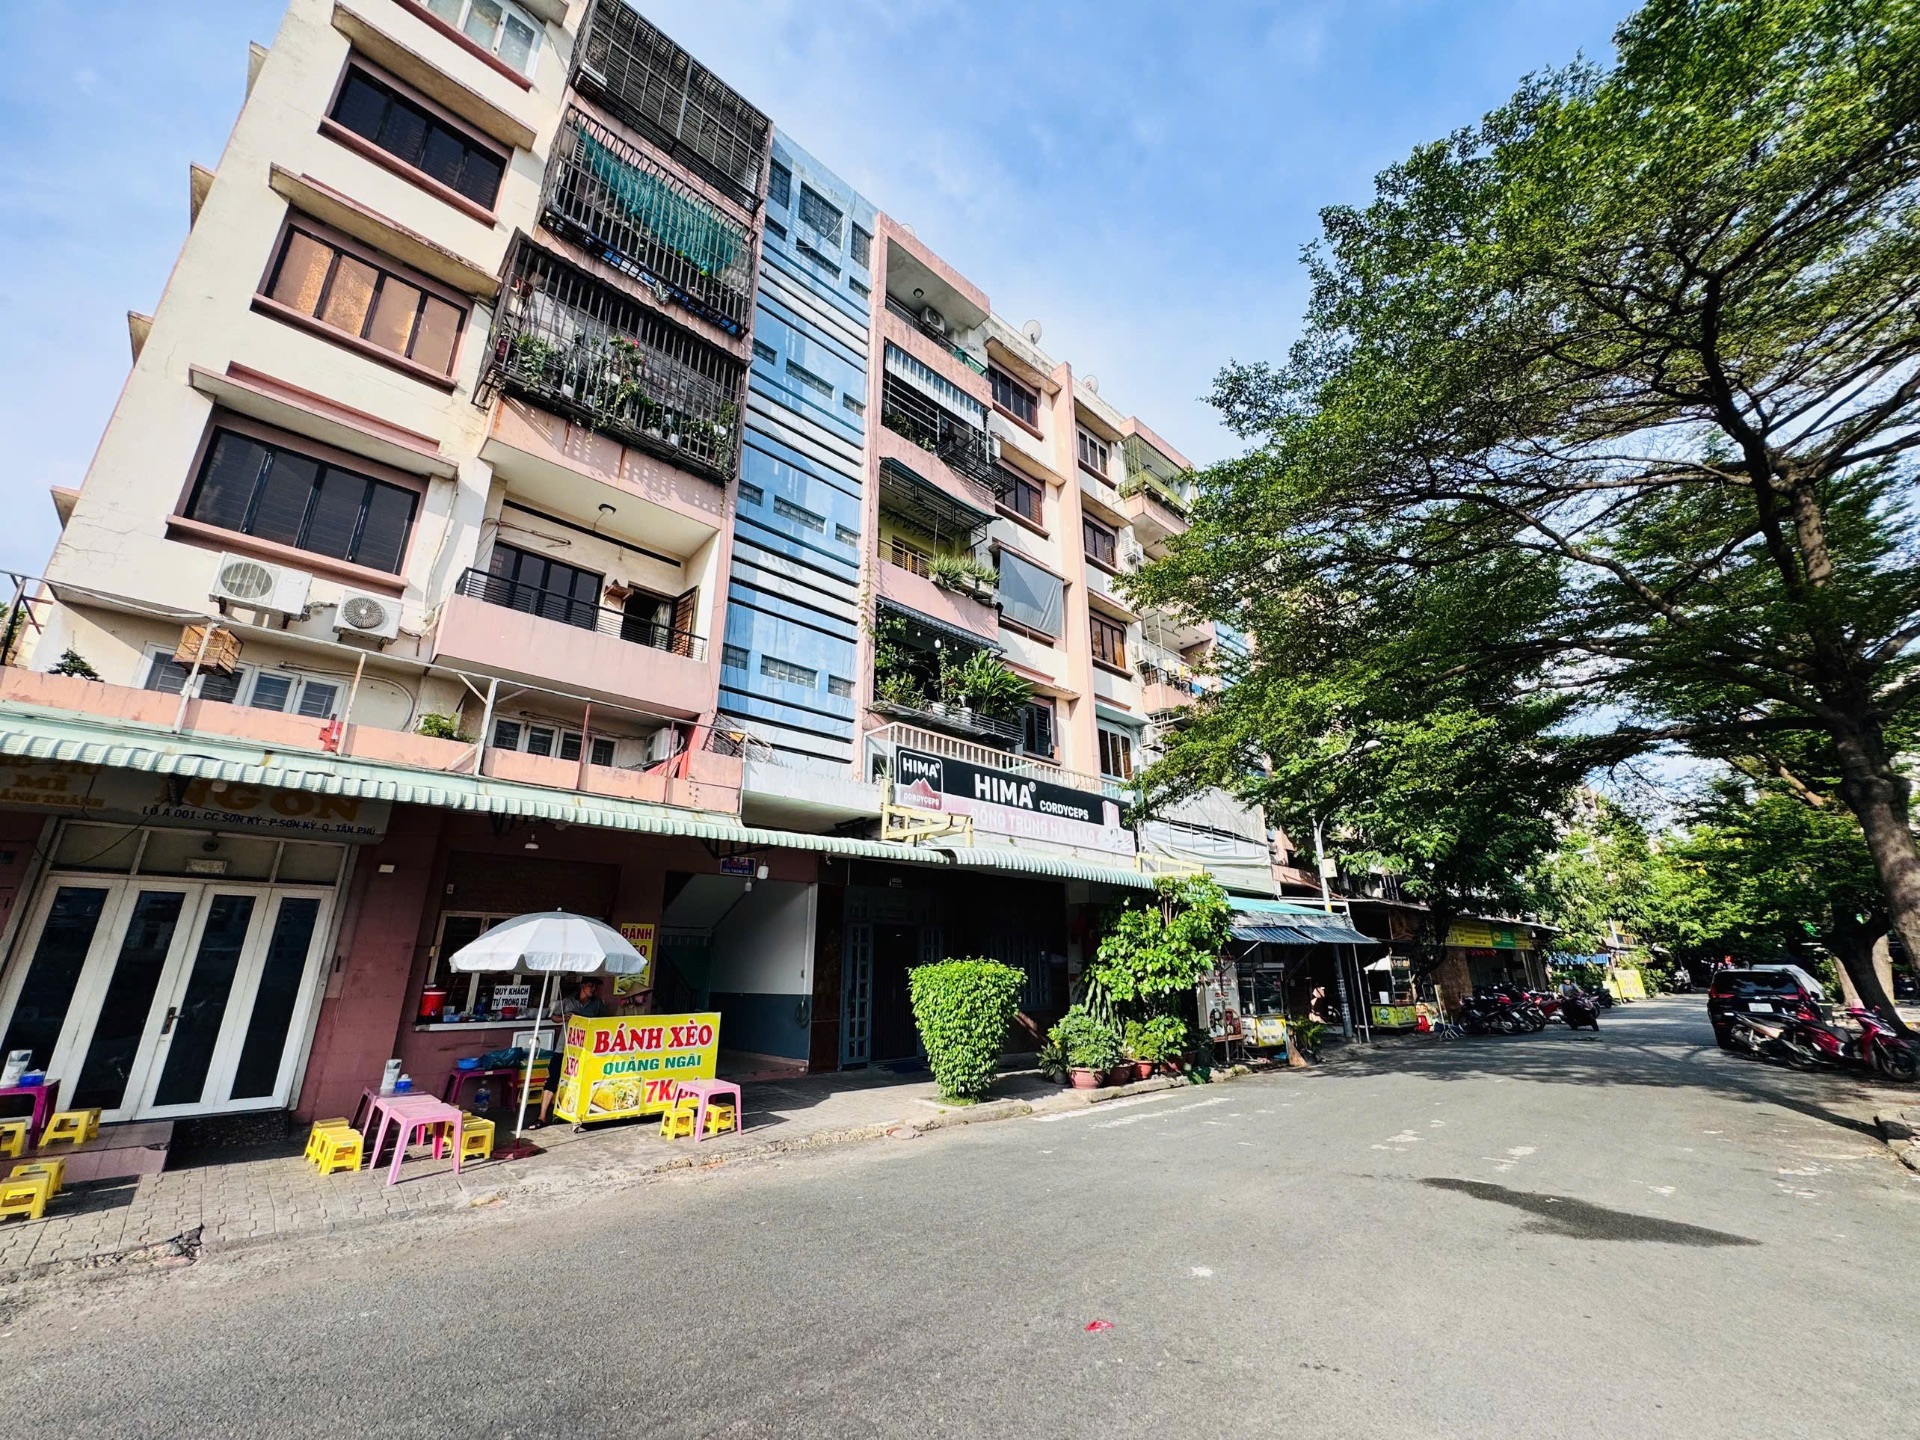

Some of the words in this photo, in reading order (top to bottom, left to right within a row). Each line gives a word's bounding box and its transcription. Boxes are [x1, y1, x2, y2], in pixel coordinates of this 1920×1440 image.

[903, 792, 940, 806] CORDYCEPS
[1039, 799, 1089, 821] CORDYCEPS
[204, 812, 219, 821] CC
[222, 813, 244, 824] SƠN
[336, 823, 354, 833] TÂN
[357, 826, 376, 836] PHÚ
[621, 925, 652, 940] BÁNH
[508, 985, 528, 995] KHÁCH
[567, 1023, 586, 1048] BÁNH
[593, 1023, 663, 1054] BÁNH
[668, 1020, 713, 1048] XÈO
[603, 1056, 660, 1075] QUẢNG
